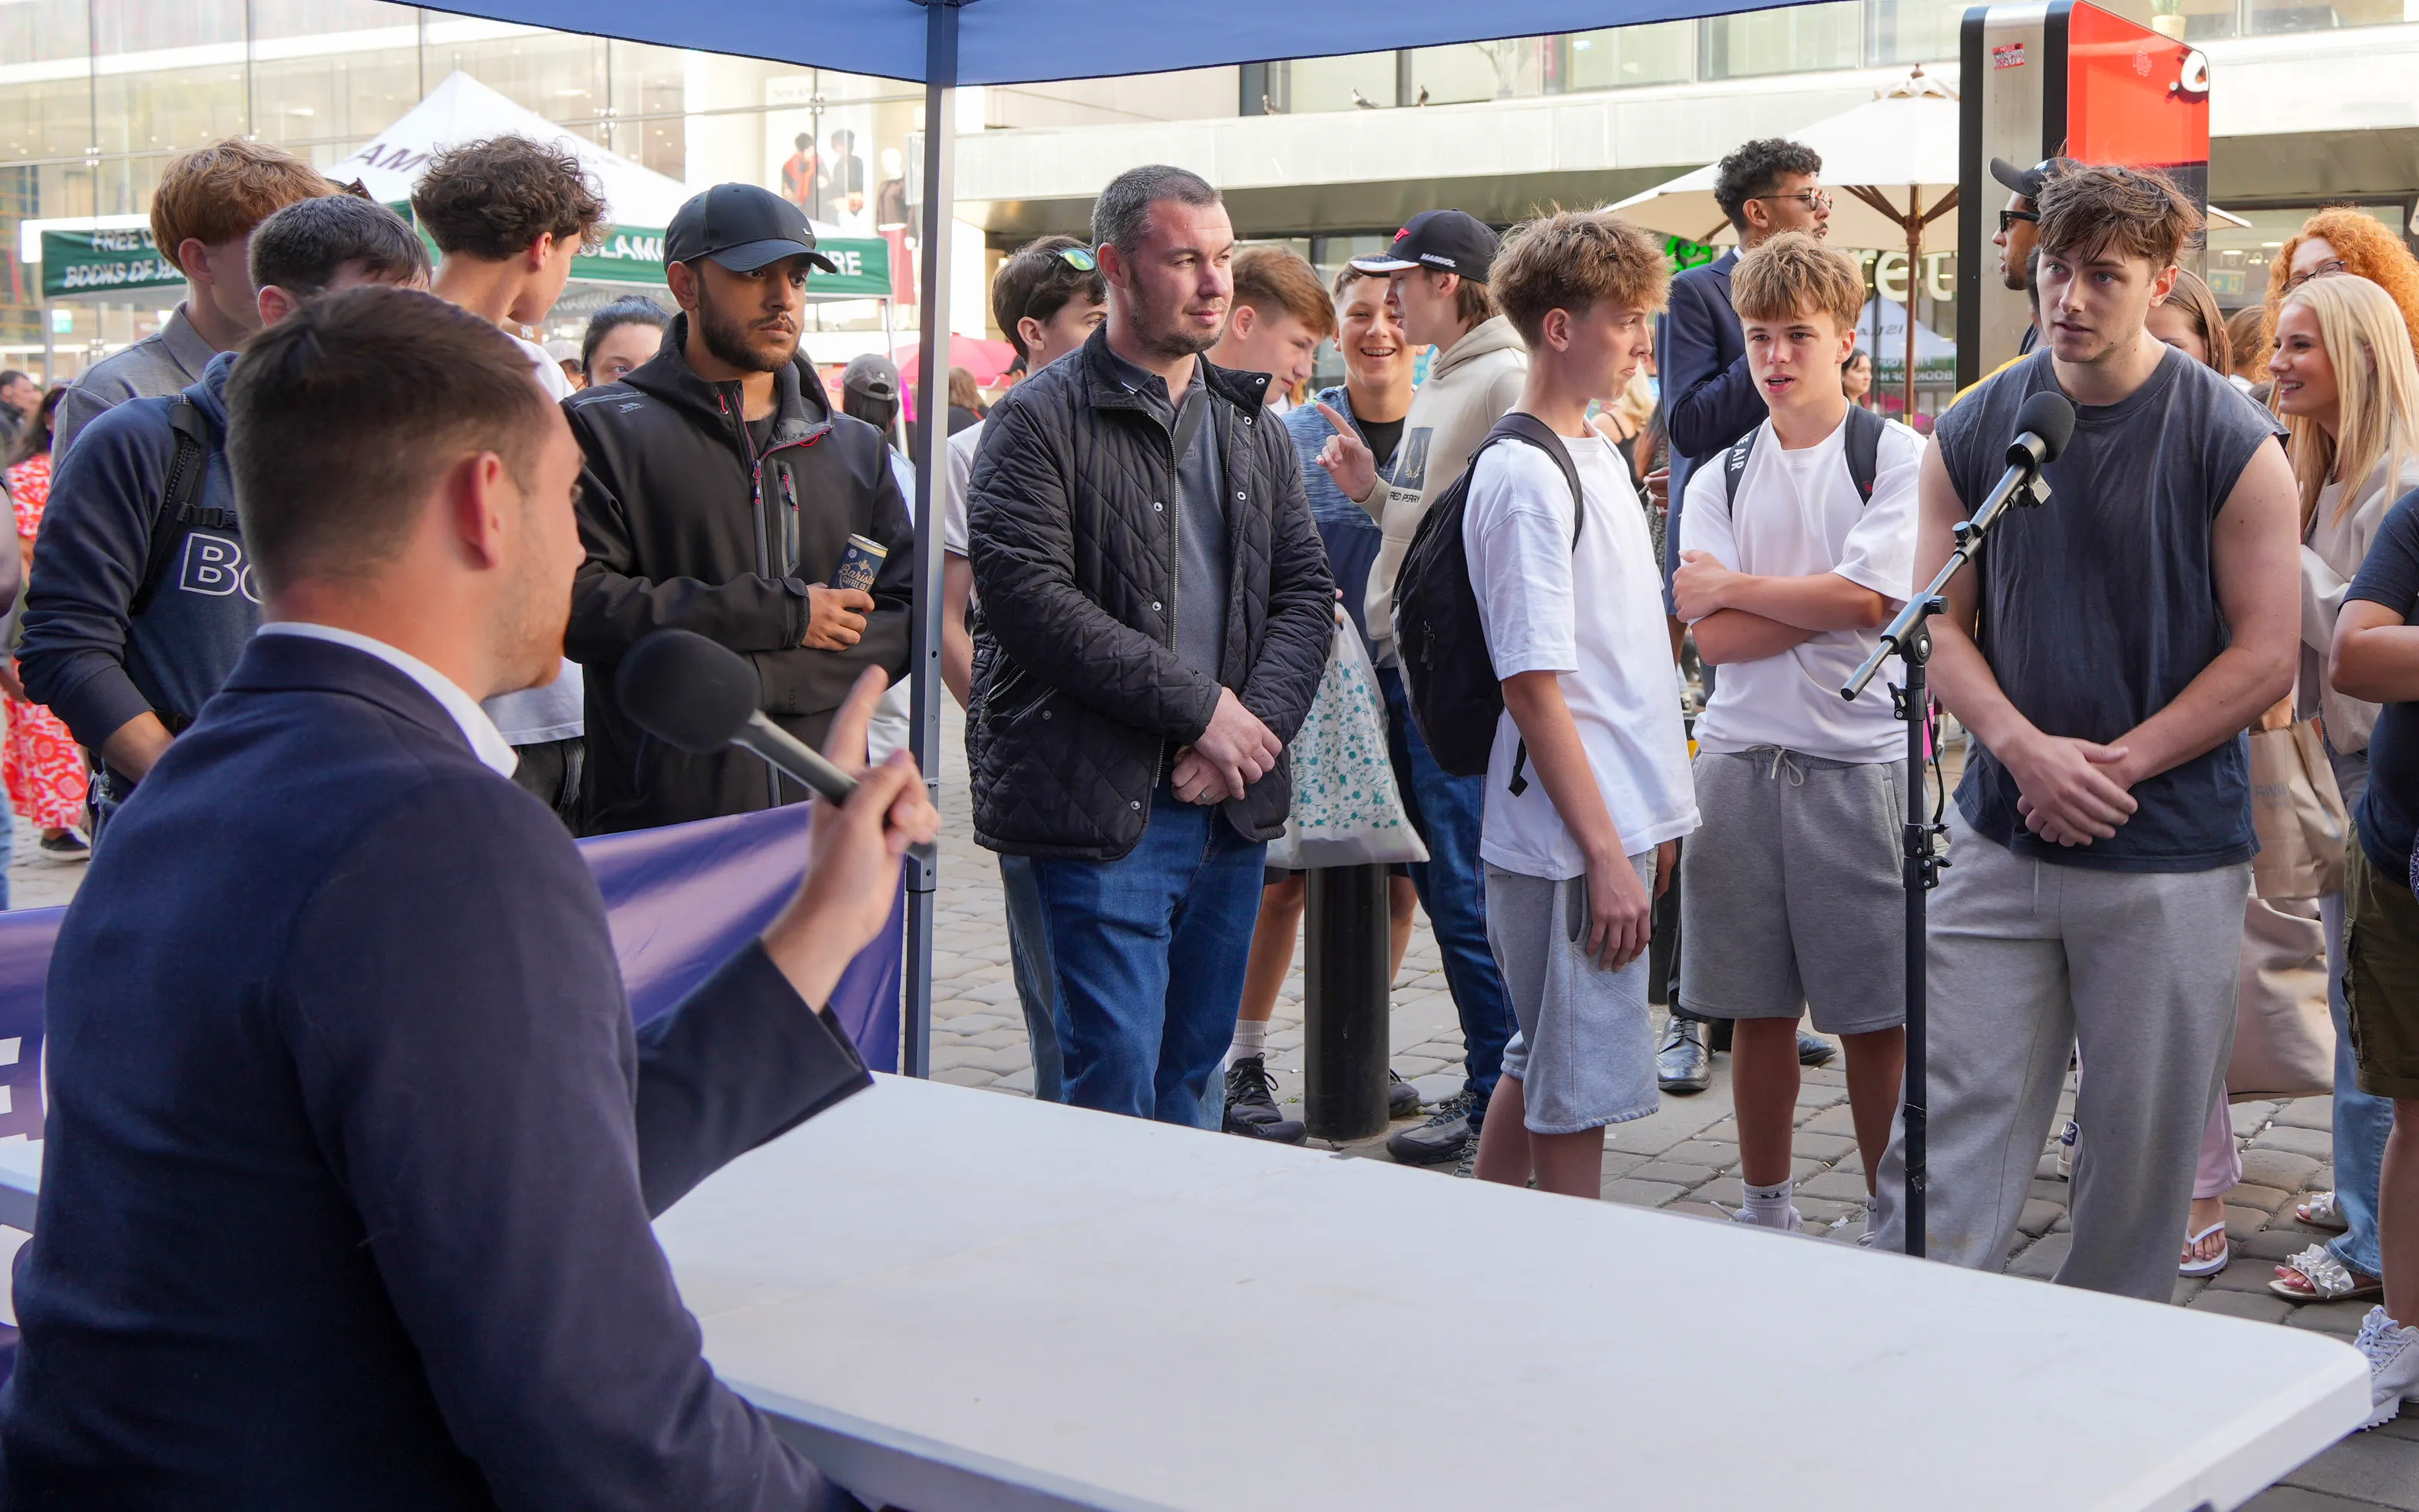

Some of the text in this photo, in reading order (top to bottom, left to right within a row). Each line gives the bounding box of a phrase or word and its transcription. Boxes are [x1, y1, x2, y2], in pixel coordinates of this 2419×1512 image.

[63, 262, 126, 289] BOOKS
[127, 259, 154, 282] OF
[1730, 447, 1747, 472] AIR
[1403, 494, 1421, 503] PERRY
[838, 563, 874, 585] Barista
[842, 576, 861, 589] COFFEE
